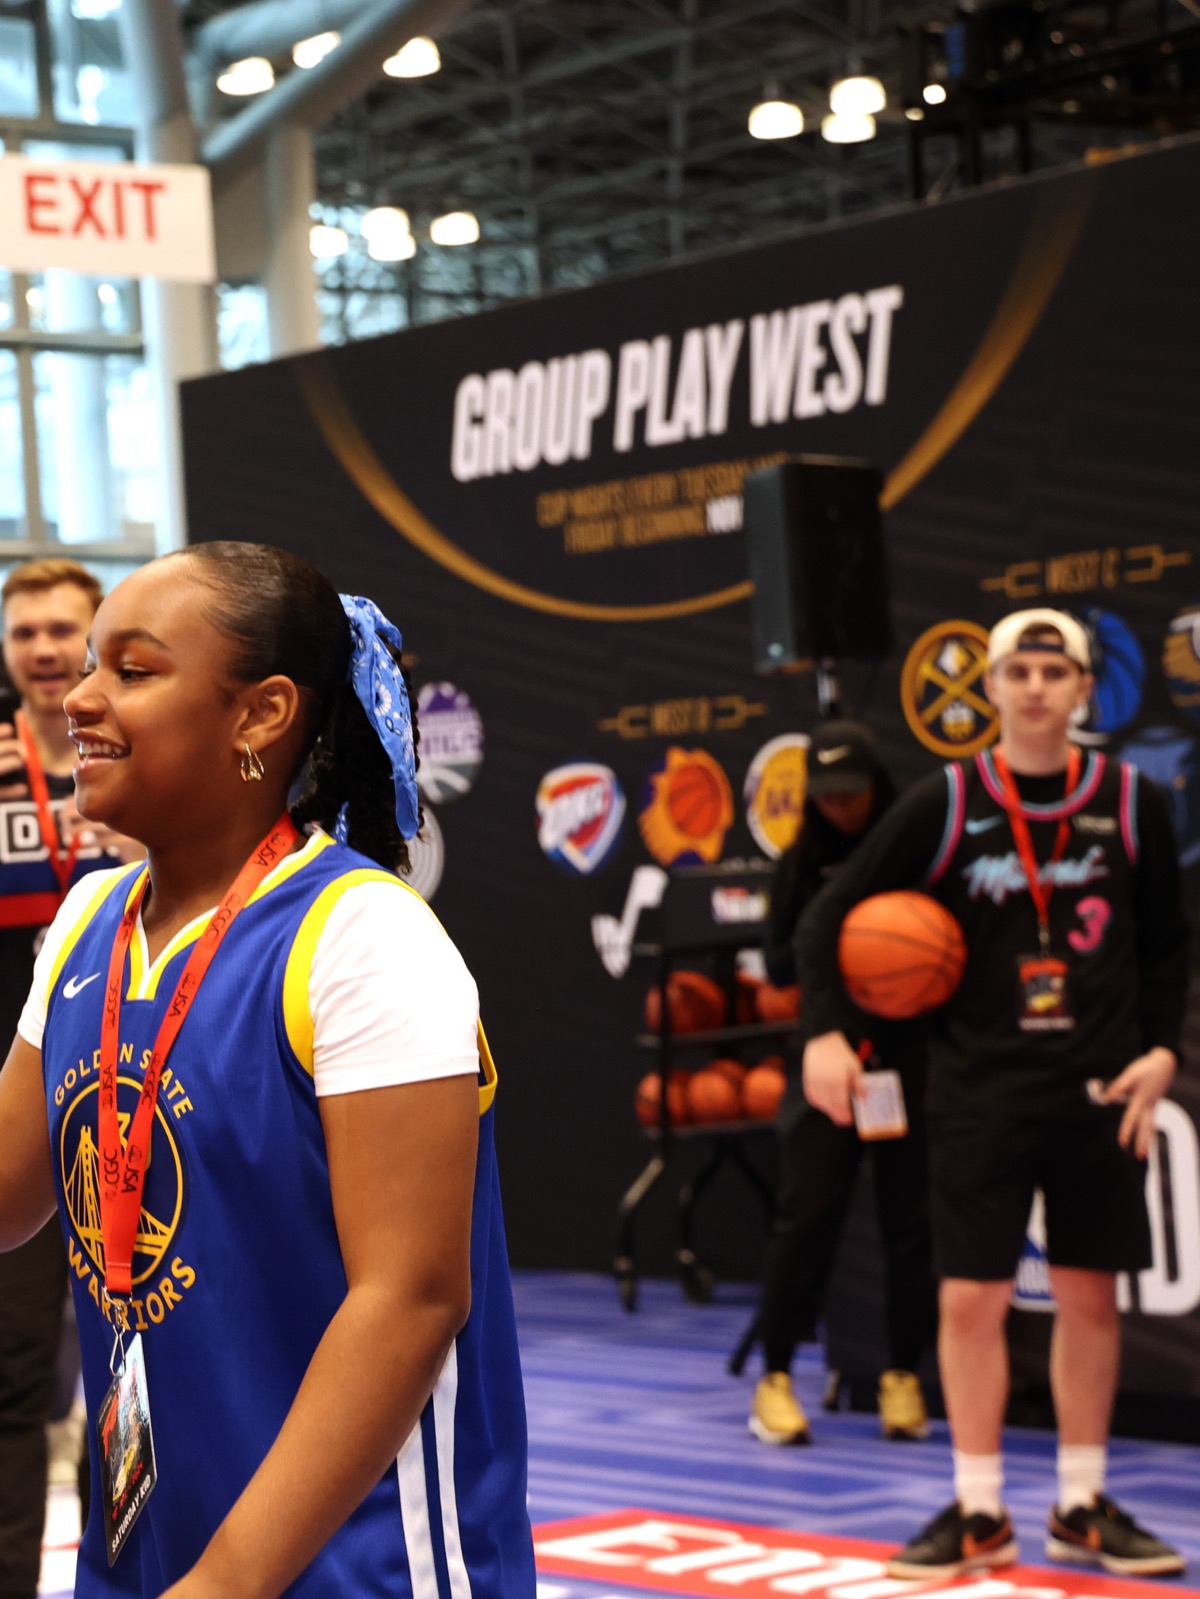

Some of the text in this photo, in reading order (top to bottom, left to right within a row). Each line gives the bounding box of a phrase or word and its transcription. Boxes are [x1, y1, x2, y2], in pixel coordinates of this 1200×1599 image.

[24, 174, 168, 242] EXIT
[450, 284, 903, 482] GROUP PLAY WEST
[1067, 896, 1112, 955] 3
[54, 1042, 194, 1119] GOLDN SATE
[68, 1236, 196, 1331] WARRIORS
[111, 1495, 140, 1553] SATURDAY
[140, 1474, 151, 1498] KID
